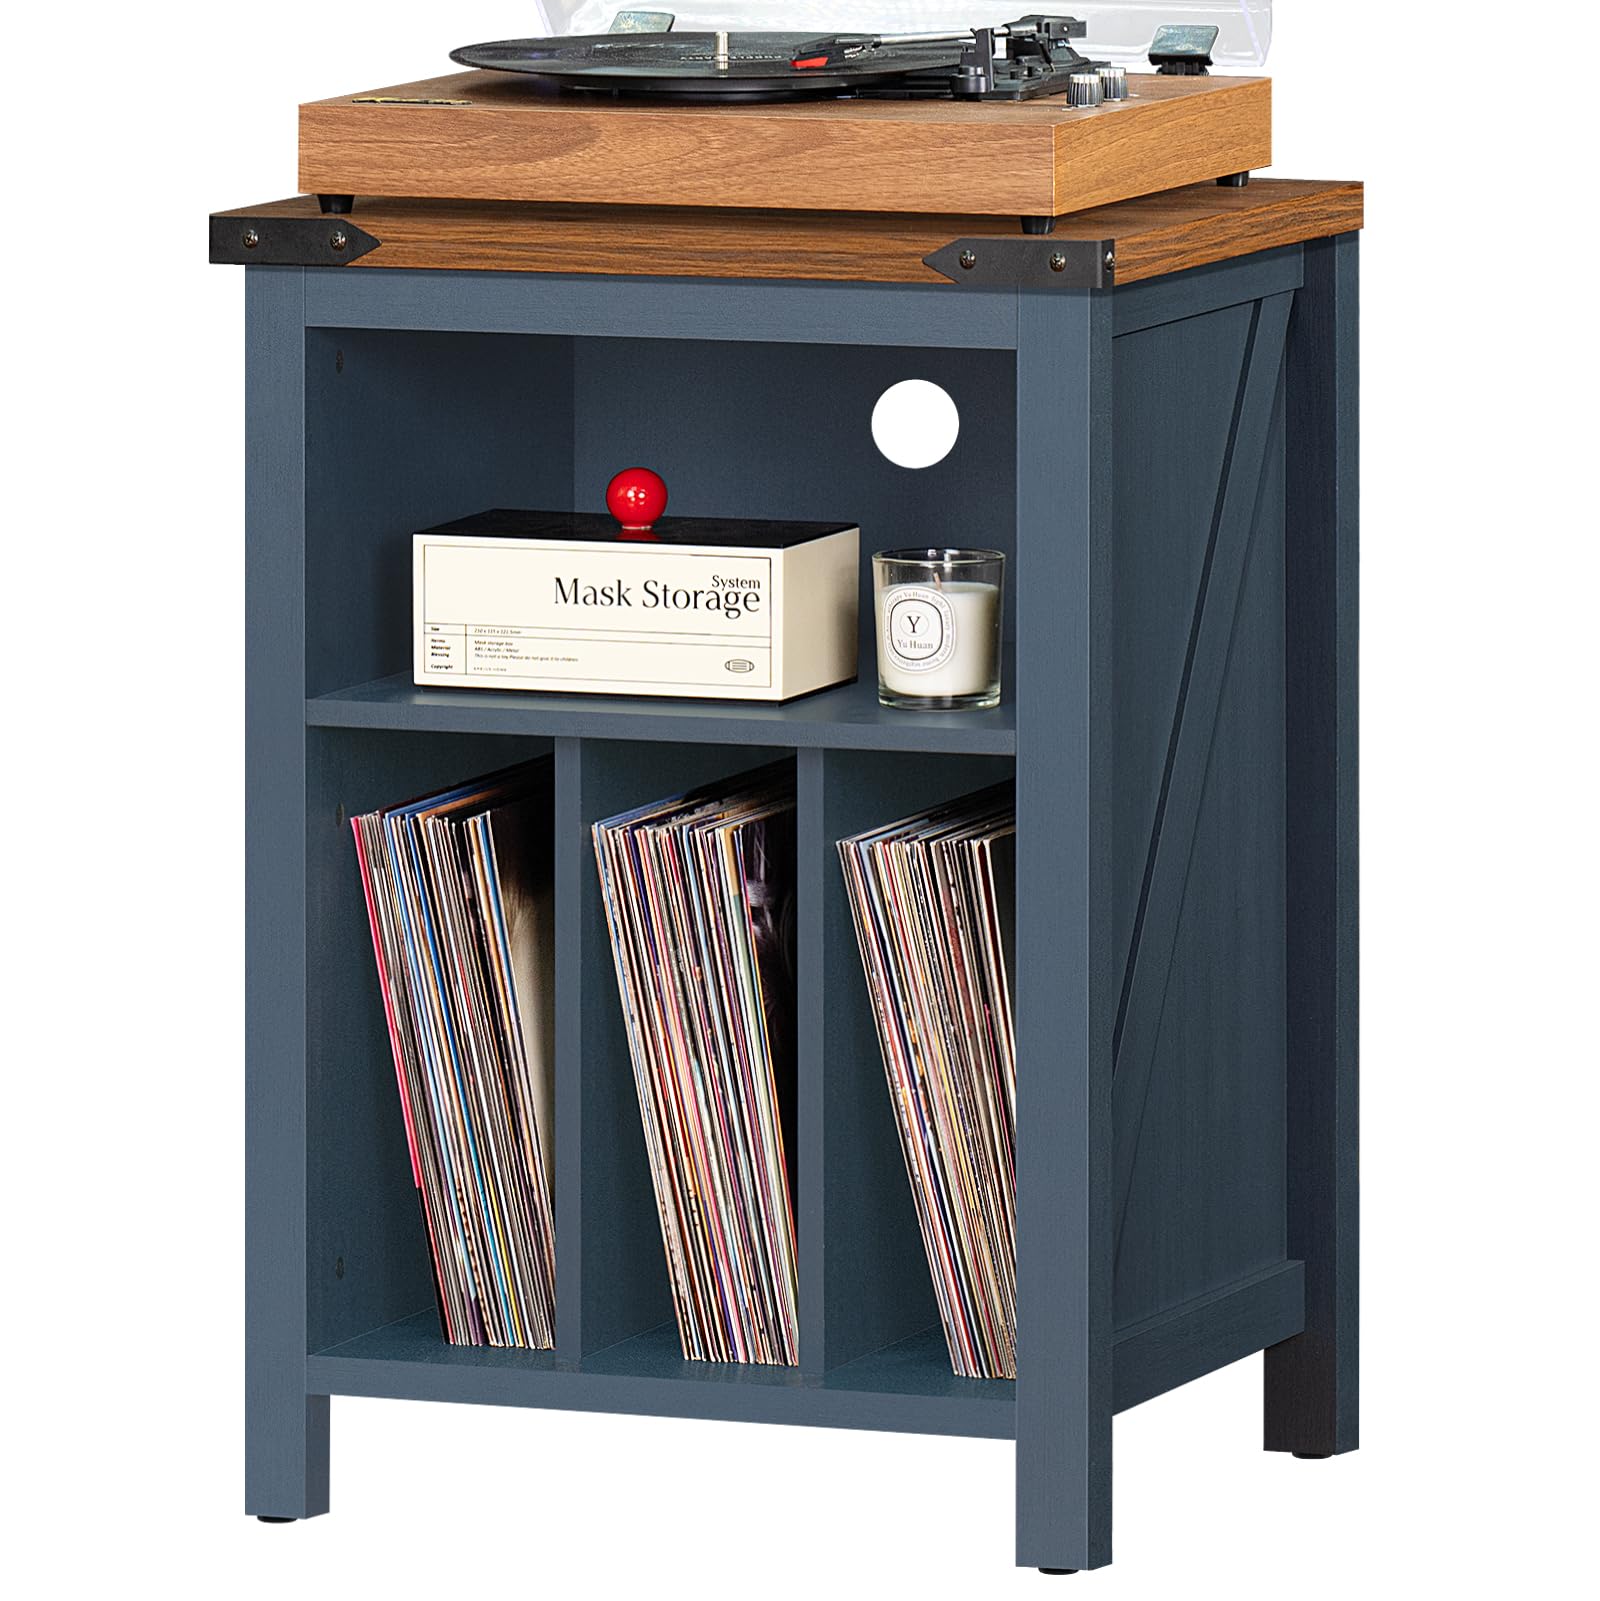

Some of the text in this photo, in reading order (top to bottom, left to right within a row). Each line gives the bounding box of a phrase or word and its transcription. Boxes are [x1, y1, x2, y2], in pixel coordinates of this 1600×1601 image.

[711, 574, 761, 591] System
[554, 576, 761, 620] Mask Storage
[906, 615, 921, 634] Y
[897, 639, 934, 650] Yu Huan
